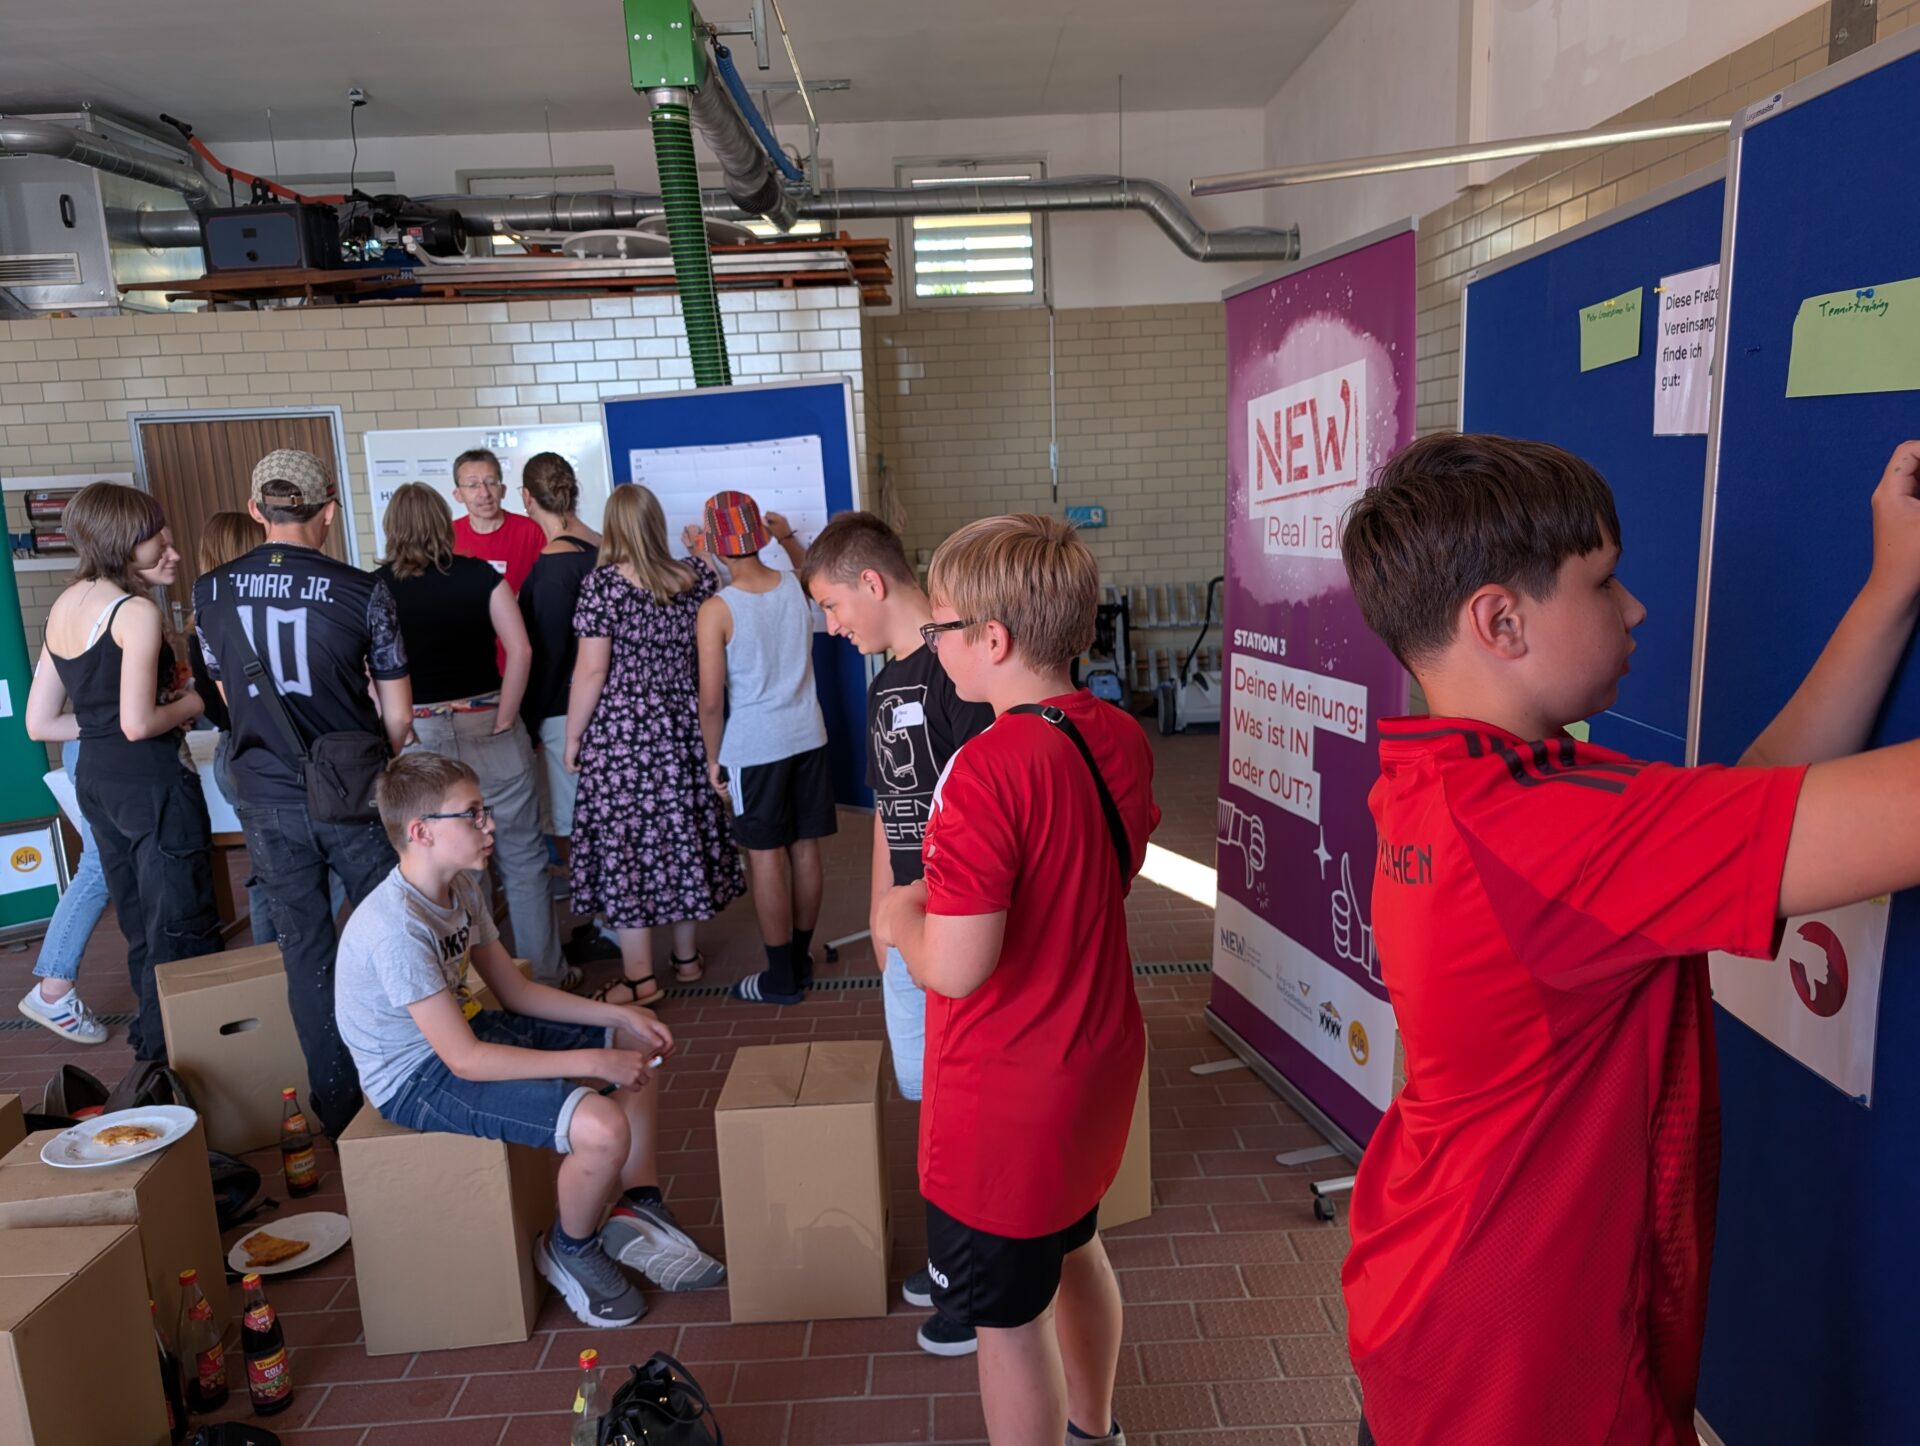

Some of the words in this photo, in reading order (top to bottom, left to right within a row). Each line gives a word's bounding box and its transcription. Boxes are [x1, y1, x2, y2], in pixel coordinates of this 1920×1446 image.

[1665, 293, 1692, 310] Diese
[1662, 345, 1688, 362] finde
[1689, 342, 1703, 360] ich
[1661, 373, 1681, 391] gut:
[1255, 378, 1352, 491] NEW
[1268, 514, 1306, 548] Real
[1312, 515, 1342, 549] Tal
[212, 573, 294, 601] YMAR
[300, 576, 334, 604] JR.
[236, 604, 313, 698] 10
[1233, 628, 1279, 656] STATION
[1280, 638, 1287, 657] 3
[1234, 667, 1277, 702] Deine
[1281, 680, 1364, 735] Meinung:
[1233, 706, 1263, 740] Was
[1267, 716, 1285, 749] ist
[1289, 727, 1309, 758] IN
[1232, 757, 1265, 788] oder
[1269, 768, 1313, 809] OUT?
[1220, 927, 1246, 956] NEW
[928, 1256, 949, 1289] KO
[264, 1362, 284, 1379] COLA
